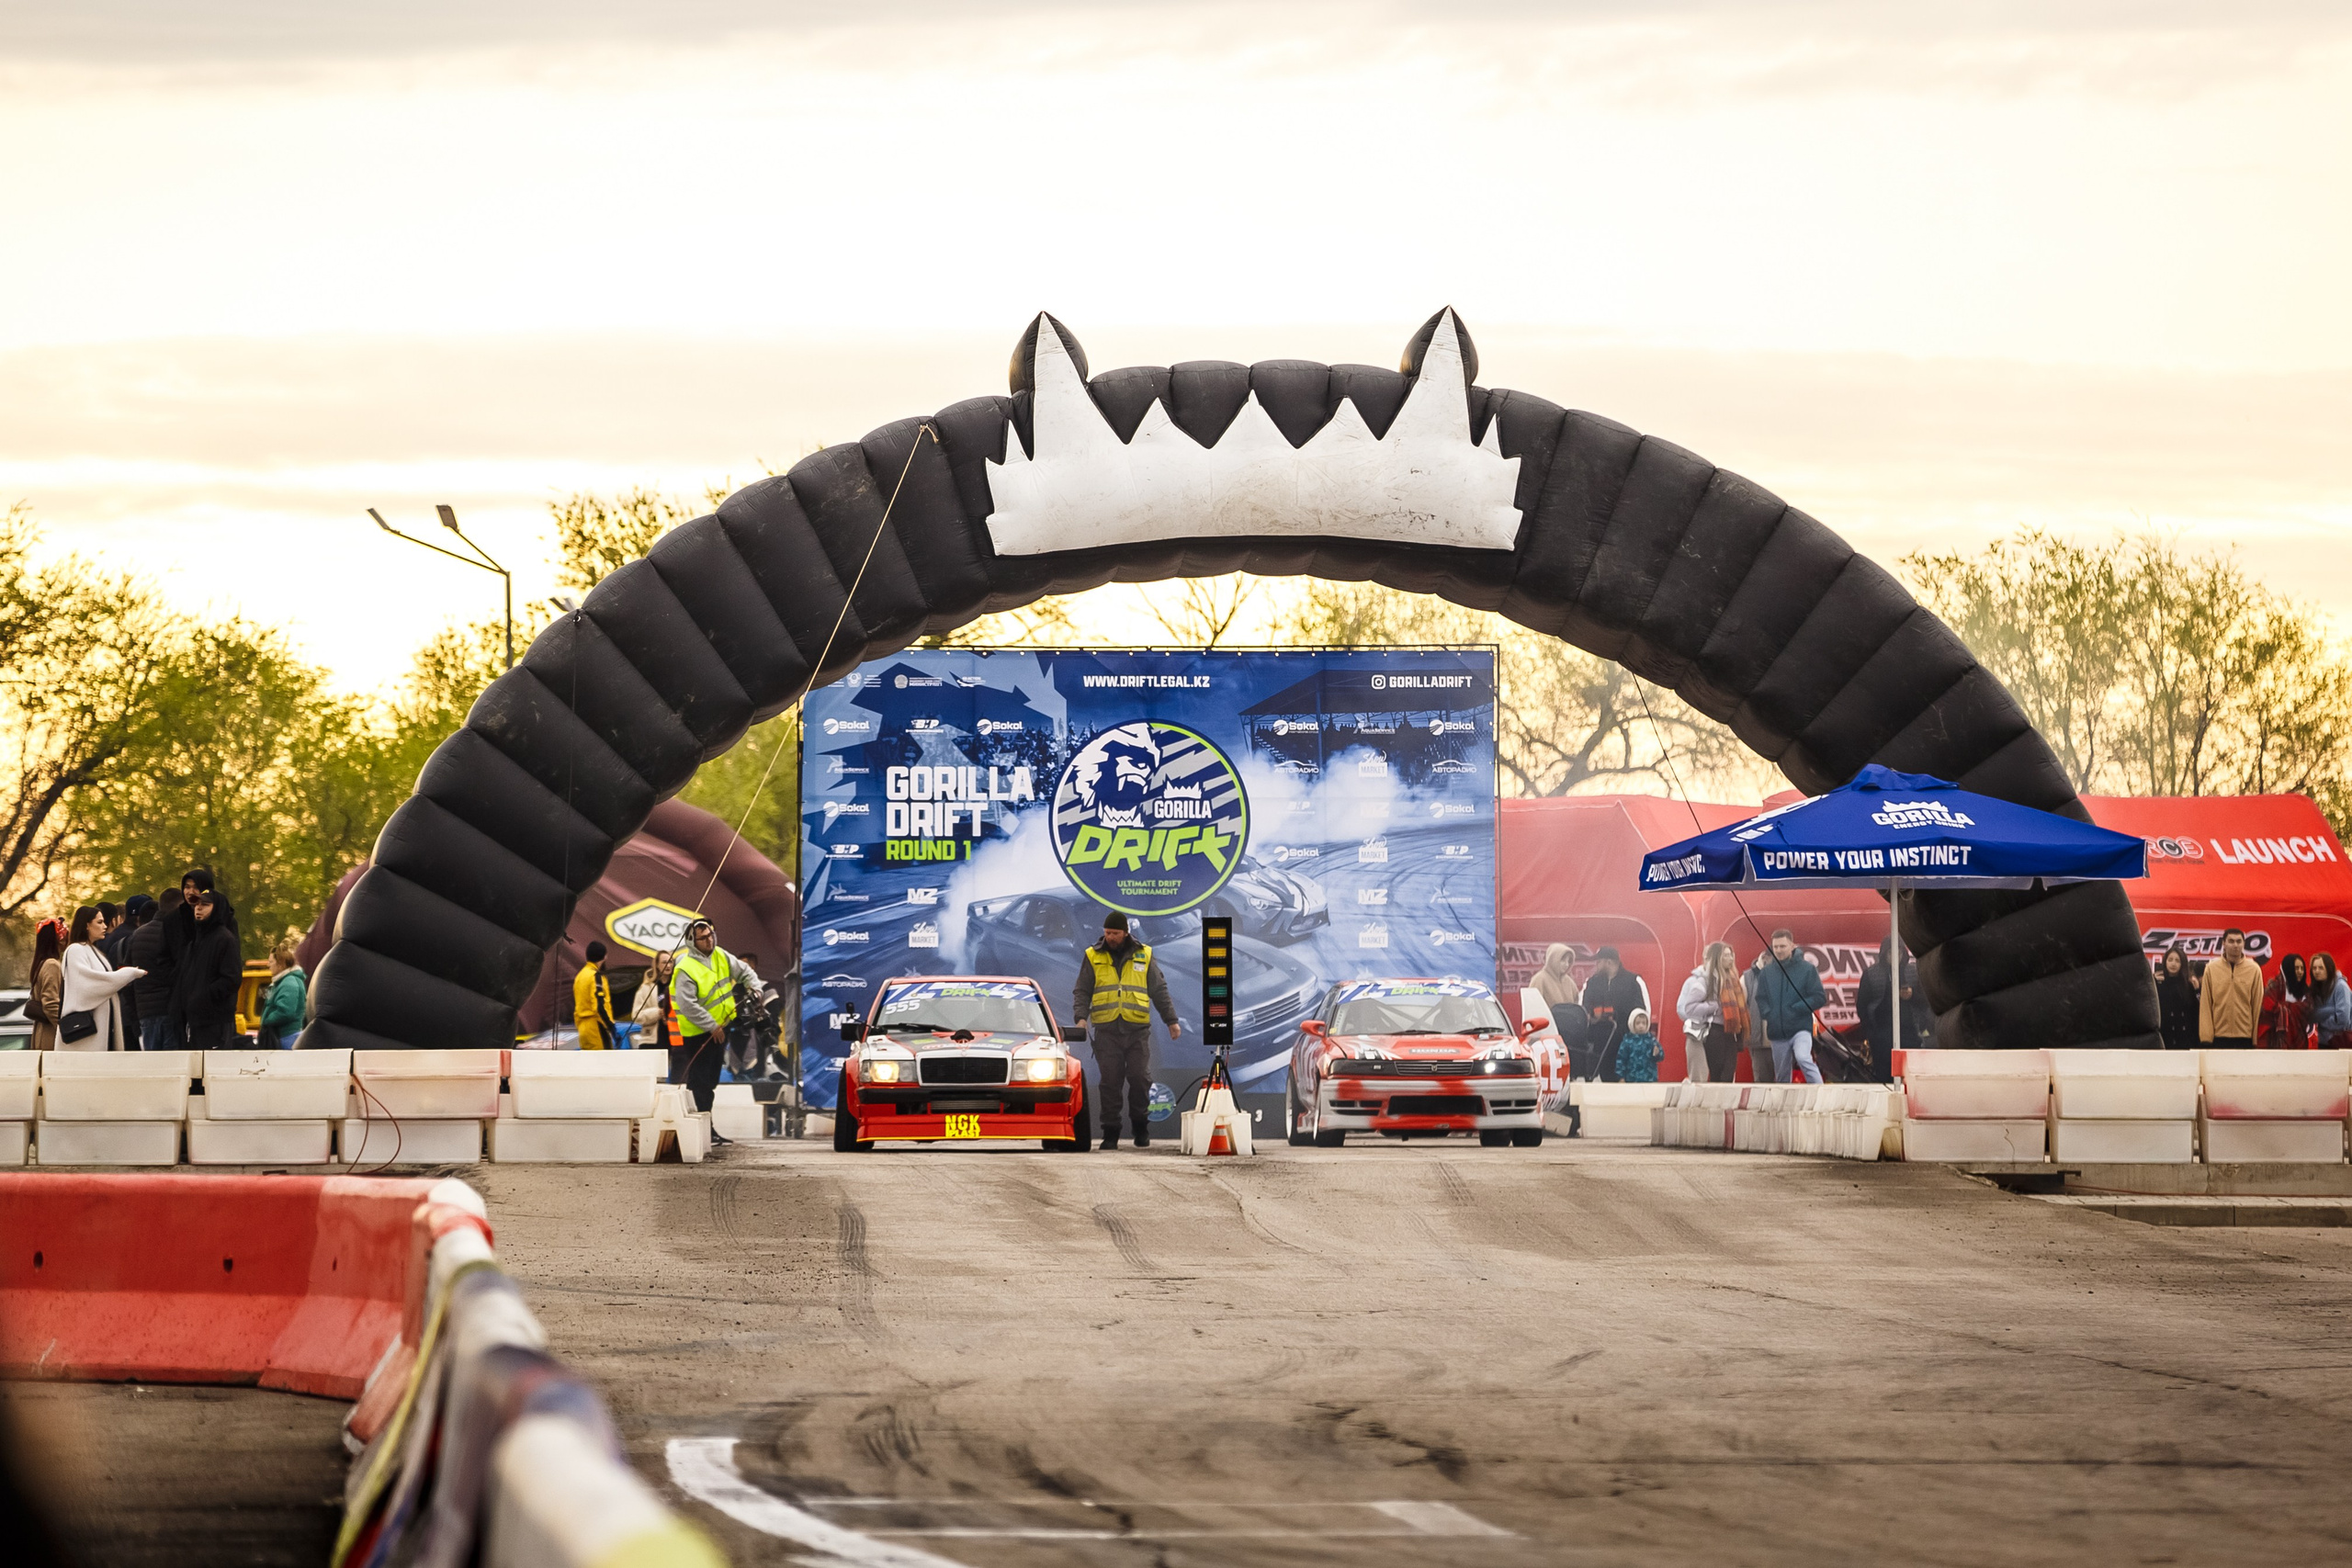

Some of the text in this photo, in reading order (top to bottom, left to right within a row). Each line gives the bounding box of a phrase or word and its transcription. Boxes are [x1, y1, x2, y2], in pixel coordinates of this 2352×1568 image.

[1082, 675, 1210, 688] WWW.DRIFTLEGAL.KZ
[1388, 676, 1473, 688] GORILLADRIFT
[839, 720, 870, 729] Sokol
[992, 721, 1023, 730] Sokol
[1288, 721, 1319, 730] Sokol
[1444, 721, 1476, 730] Sokol
[886, 766, 1035, 801] GORILLA
[839, 803, 870, 812] Sokol
[1154, 800, 1213, 819] GORILLA
[1444, 804, 1476, 813] Sokol
[886, 802, 989, 837] DRIFT
[1871, 808, 1975, 826] GORILLA
[1894, 819, 1966, 829] ENERGY DRINK
[886, 840, 971, 861] ROUND 1
[1066, 824, 1232, 874] DRIFT
[1289, 848, 1320, 857] Sokol
[2210, 835, 2337, 864] LAUNCH
[1763, 845, 1972, 871] POWER YOUR INSTINCT
[1116, 879, 1182, 887] ULTIMATE DRIFT
[907, 888, 938, 905] MZ
[1121, 887, 1179, 896] TOURNAMENT
[1358, 889, 1388, 905] MZ
[623, 921, 689, 938] YACC
[838, 931, 870, 941] Sokol
[911, 936, 936, 944] MARKET
[1361, 936, 1385, 944] MARKET
[1444, 931, 1476, 942] Sokol
[885, 998, 920, 1015] 555
